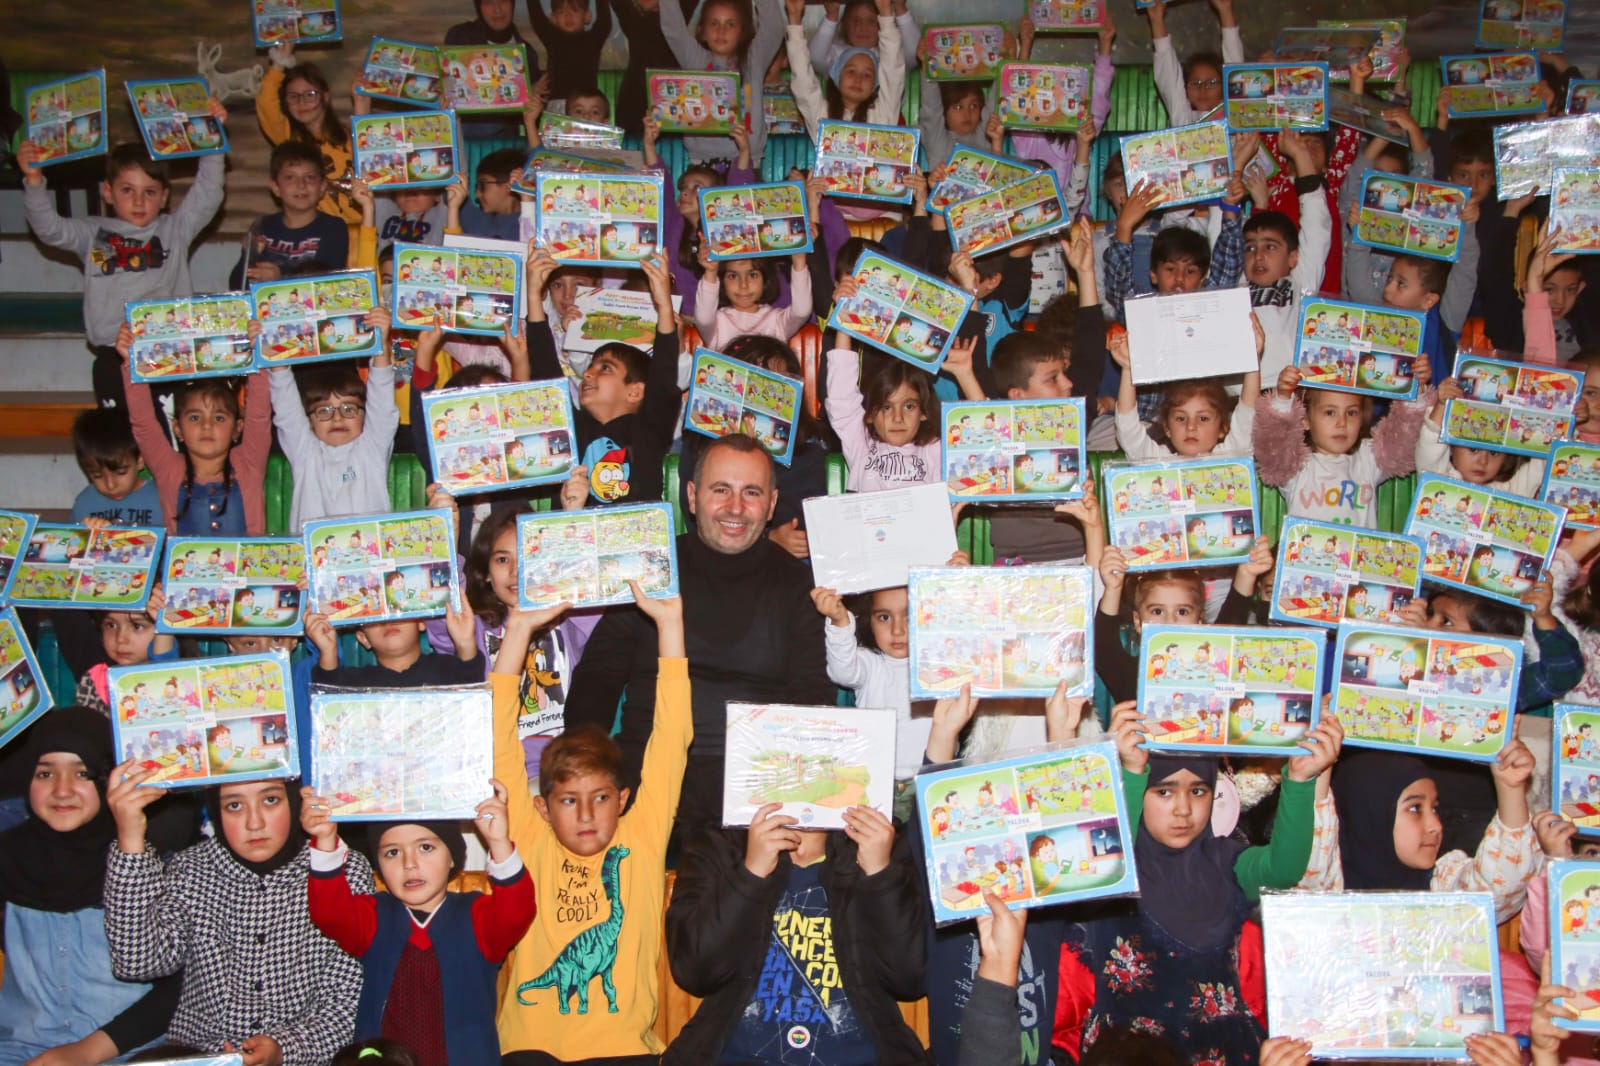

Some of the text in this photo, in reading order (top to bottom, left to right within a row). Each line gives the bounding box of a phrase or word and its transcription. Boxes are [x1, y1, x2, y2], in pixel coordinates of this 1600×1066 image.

[1299, 480, 1373, 510] WORLD
[128, 508, 152, 525] THE
[557, 888, 598, 907] REALLY
